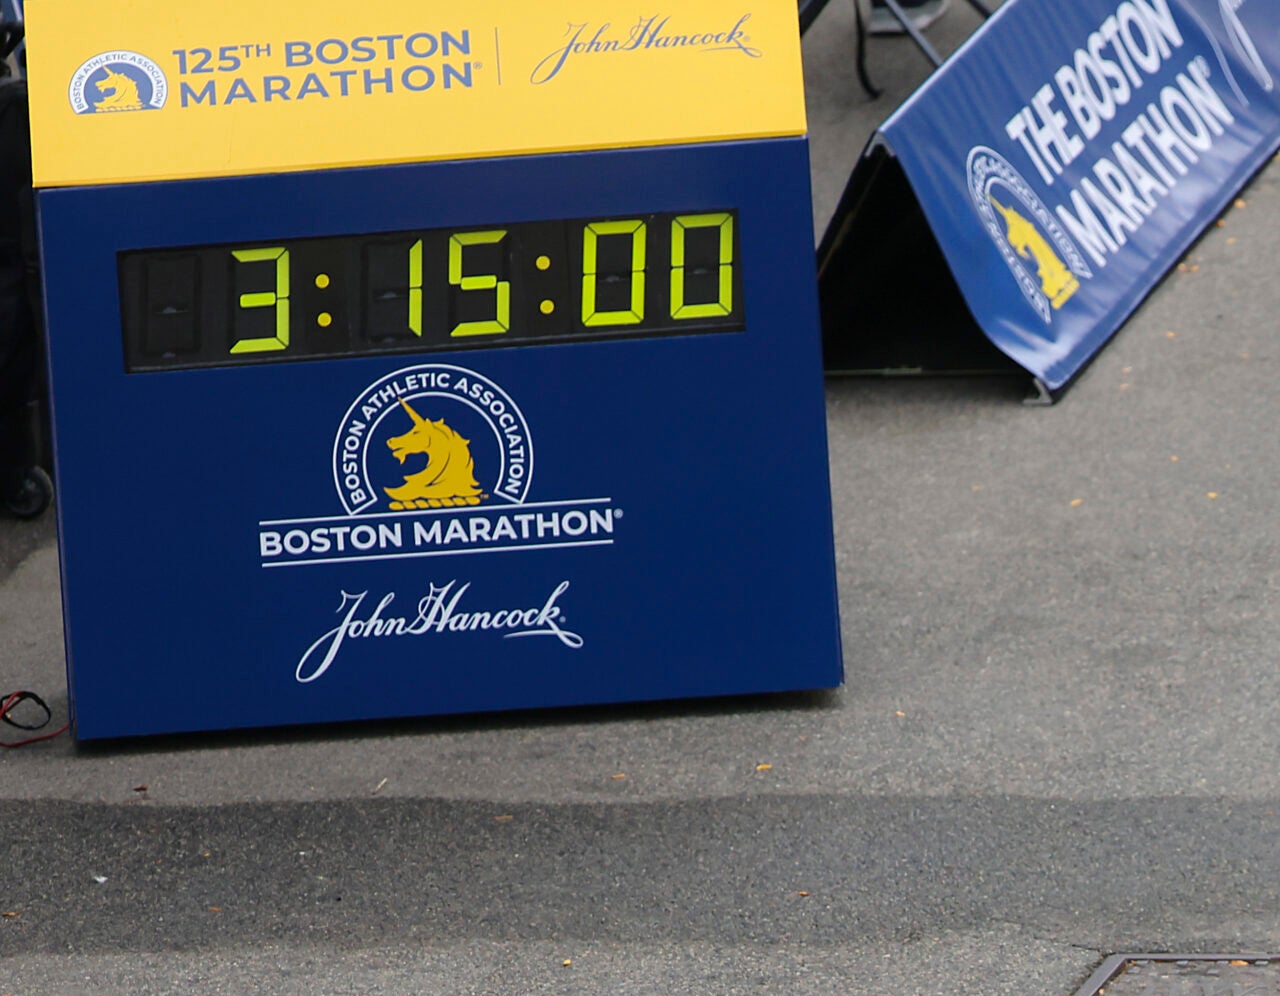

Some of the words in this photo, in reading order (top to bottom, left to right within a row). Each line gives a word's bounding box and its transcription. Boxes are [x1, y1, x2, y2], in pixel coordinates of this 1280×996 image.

[72, 75, 86, 110] BOSTON
[84, 53, 128, 75] ATHLETIC
[128, 55, 164, 104] ASSOCIATION
[172, 43, 271, 75] 125TH
[284, 30, 471, 68] BOSTON
[530, 22, 620, 85] John
[619, 13, 763, 58] Hancock
[1006, 85, 1084, 185] THE
[1055, 0, 1184, 139] BOSTON
[229, 213, 734, 354] 3:15:00
[343, 420, 367, 505] BOSTON
[361, 373, 450, 421] ATHLETIC
[453, 377, 525, 494] ASSOCIATION
[259, 523, 403, 556] BOSTON
[295, 589, 406, 683] John
[405, 579, 584, 649] Hancock
